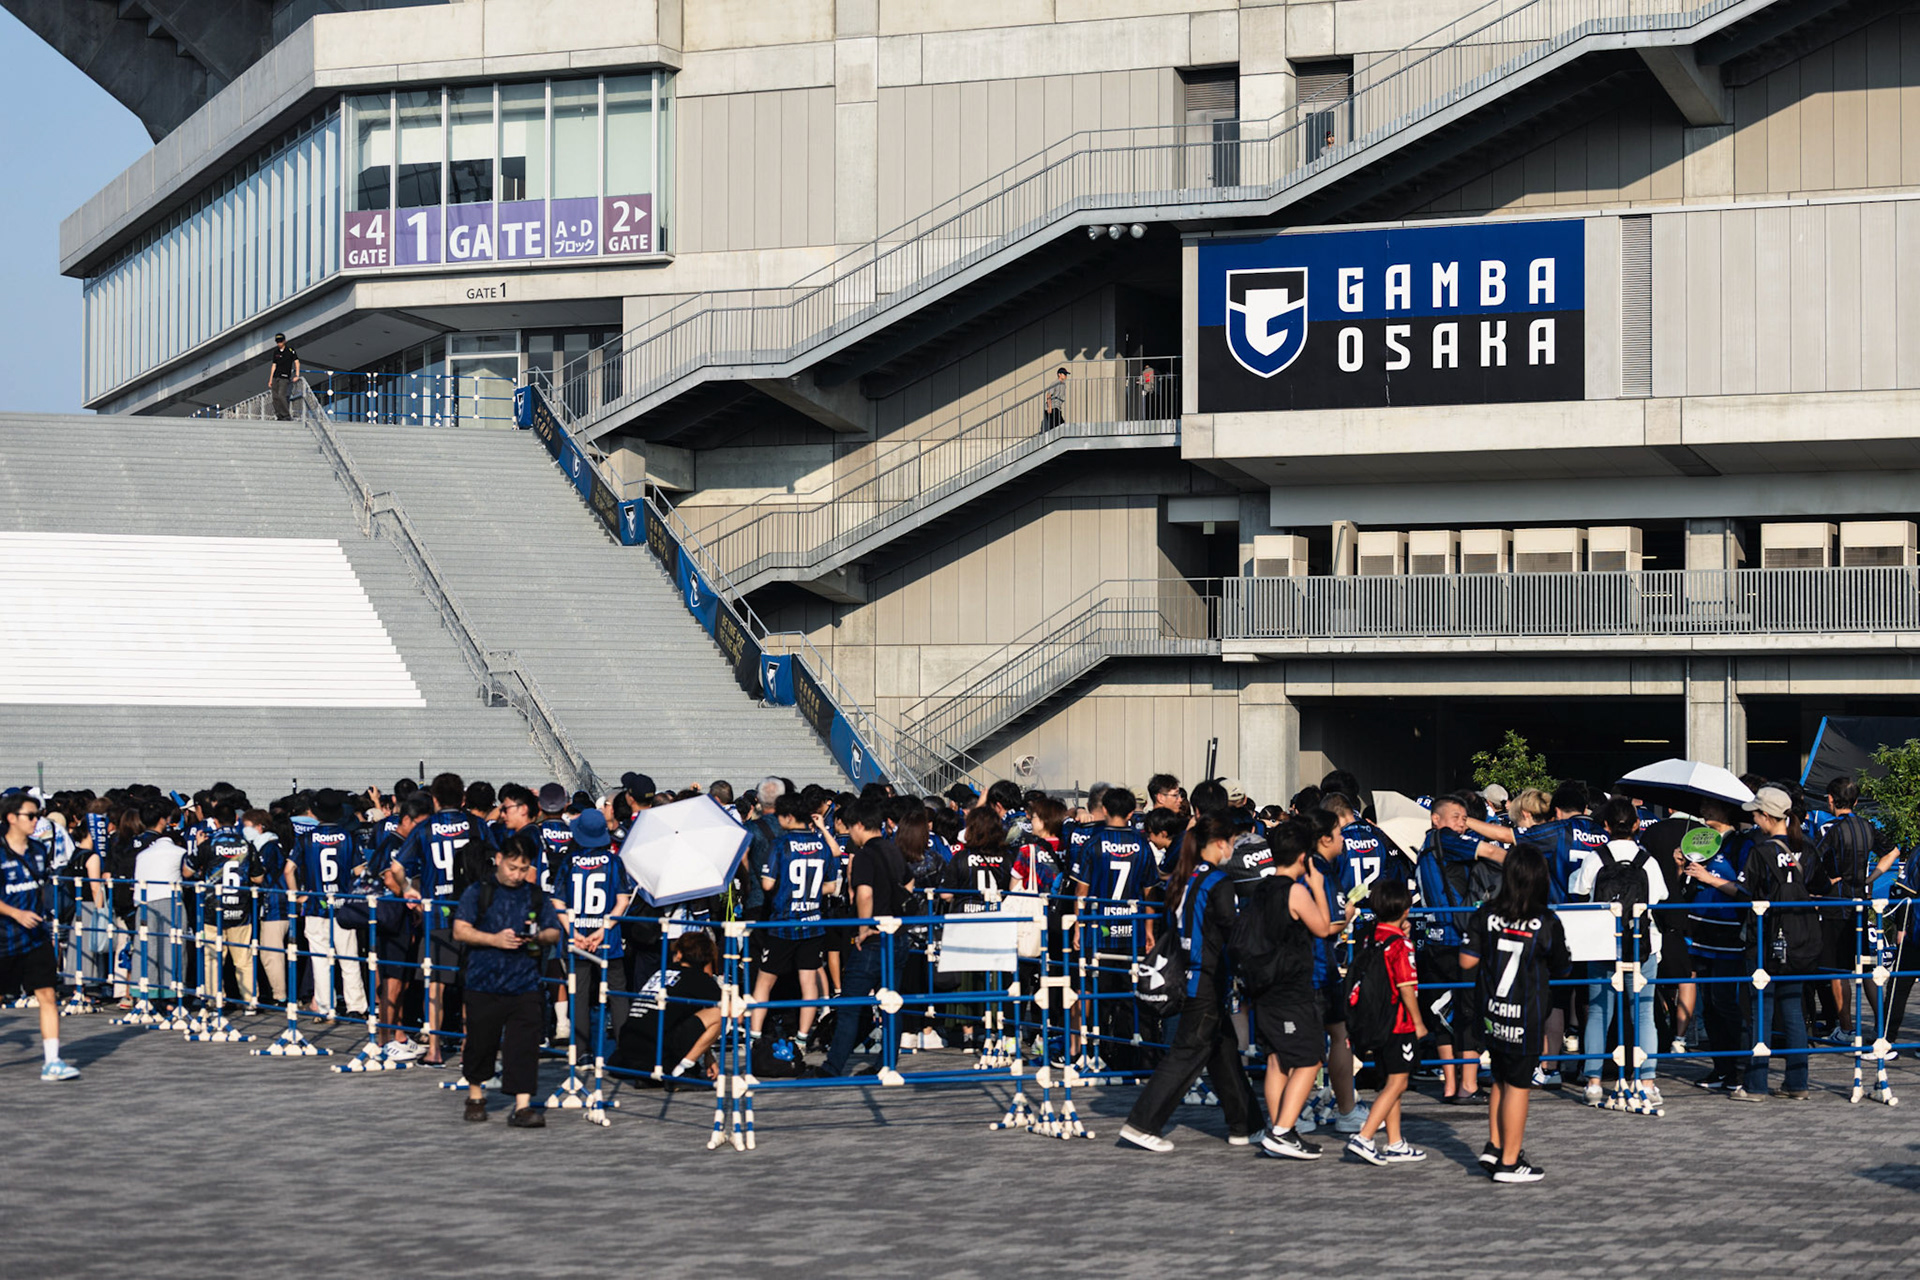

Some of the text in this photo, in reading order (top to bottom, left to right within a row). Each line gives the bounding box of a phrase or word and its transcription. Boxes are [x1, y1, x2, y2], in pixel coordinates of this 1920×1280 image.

[612, 201, 631, 232] 2
[366, 214, 385, 245] 4
[407, 211, 543, 262] 1 GATE
[554, 239, 595, 254] ブロック
[608, 234, 649, 252] GATE
[348, 249, 387, 265] GATE
[466, 282, 507, 299] GATE 1
[1338, 257, 1556, 313] GAMBA
[1338, 318, 1556, 372] OSAKA
[312, 832, 345, 842] ROHTO
[431, 821, 470, 835] ROHTO
[542, 828, 573, 840] ROHT
[1573, 829, 1608, 844] ROHTO
[215, 845, 248, 856] ROHTO
[790, 841, 823, 852] ROHTO
[1102, 840, 1140, 853] ROHTO
[1345, 838, 1379, 850] ROHTO
[320, 847, 338, 882] 6
[1242, 848, 1272, 869] ROHT
[222, 860, 240, 894] 6
[789, 858, 825, 898] 97
[1110, 861, 1131, 900] 7
[572, 872, 607, 914] 16
[1495, 938, 1524, 998] 7
[1493, 1022, 1525, 1039] SHIP
